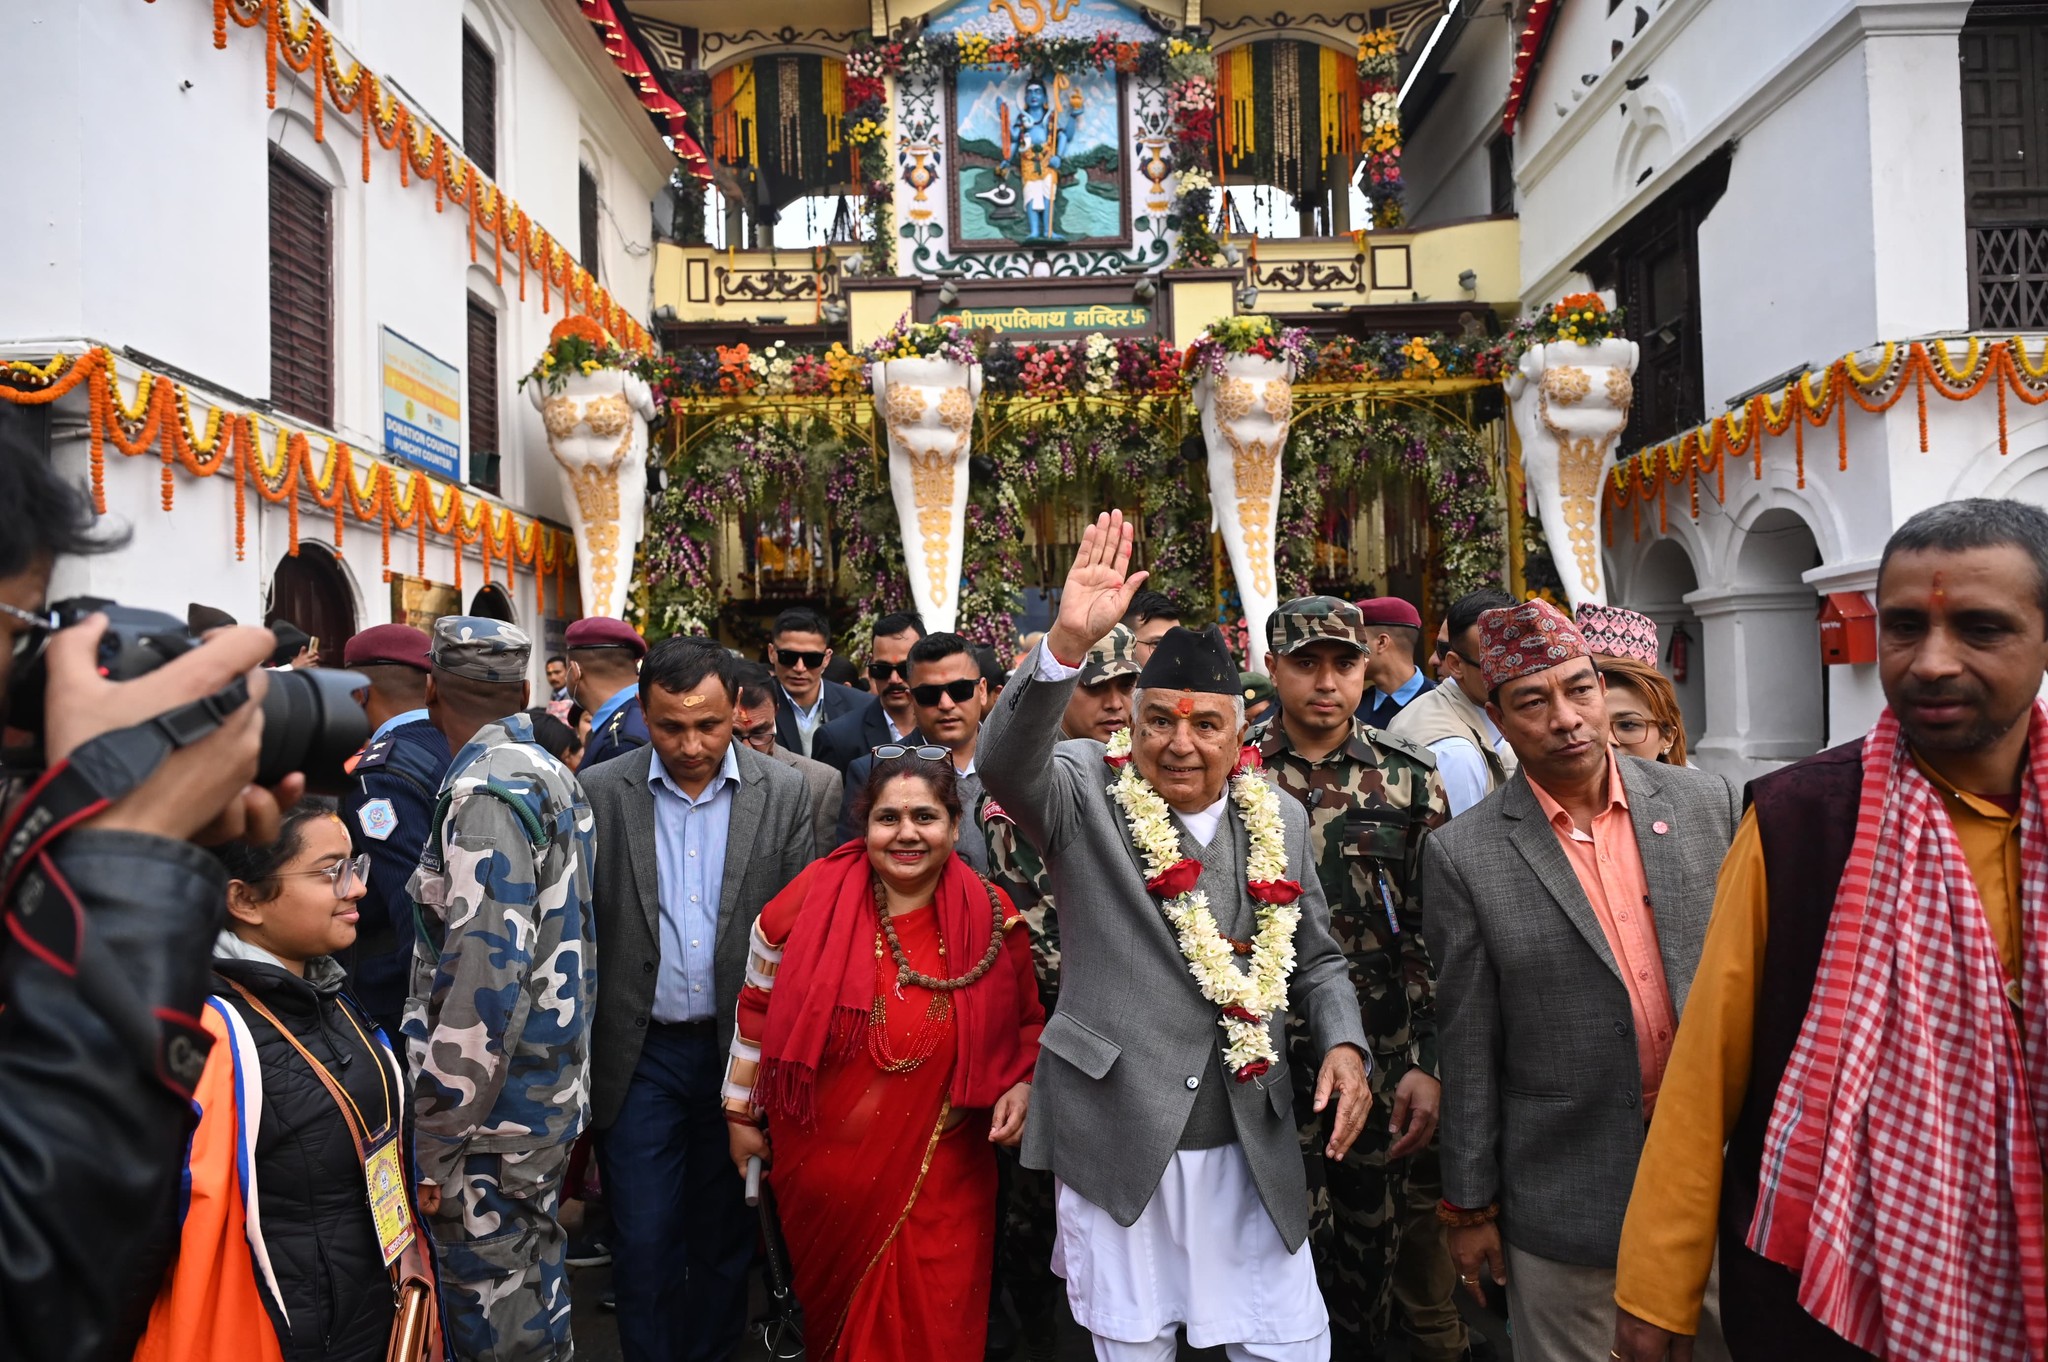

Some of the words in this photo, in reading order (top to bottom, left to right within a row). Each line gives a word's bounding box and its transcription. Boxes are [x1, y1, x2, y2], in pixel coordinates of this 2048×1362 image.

[1073, 305, 1130, 328] मन्दिर
[386, 417, 425, 444] DONATION
[426, 435, 459, 460] COUNTER
[422, 449, 453, 472] COUNTER)
